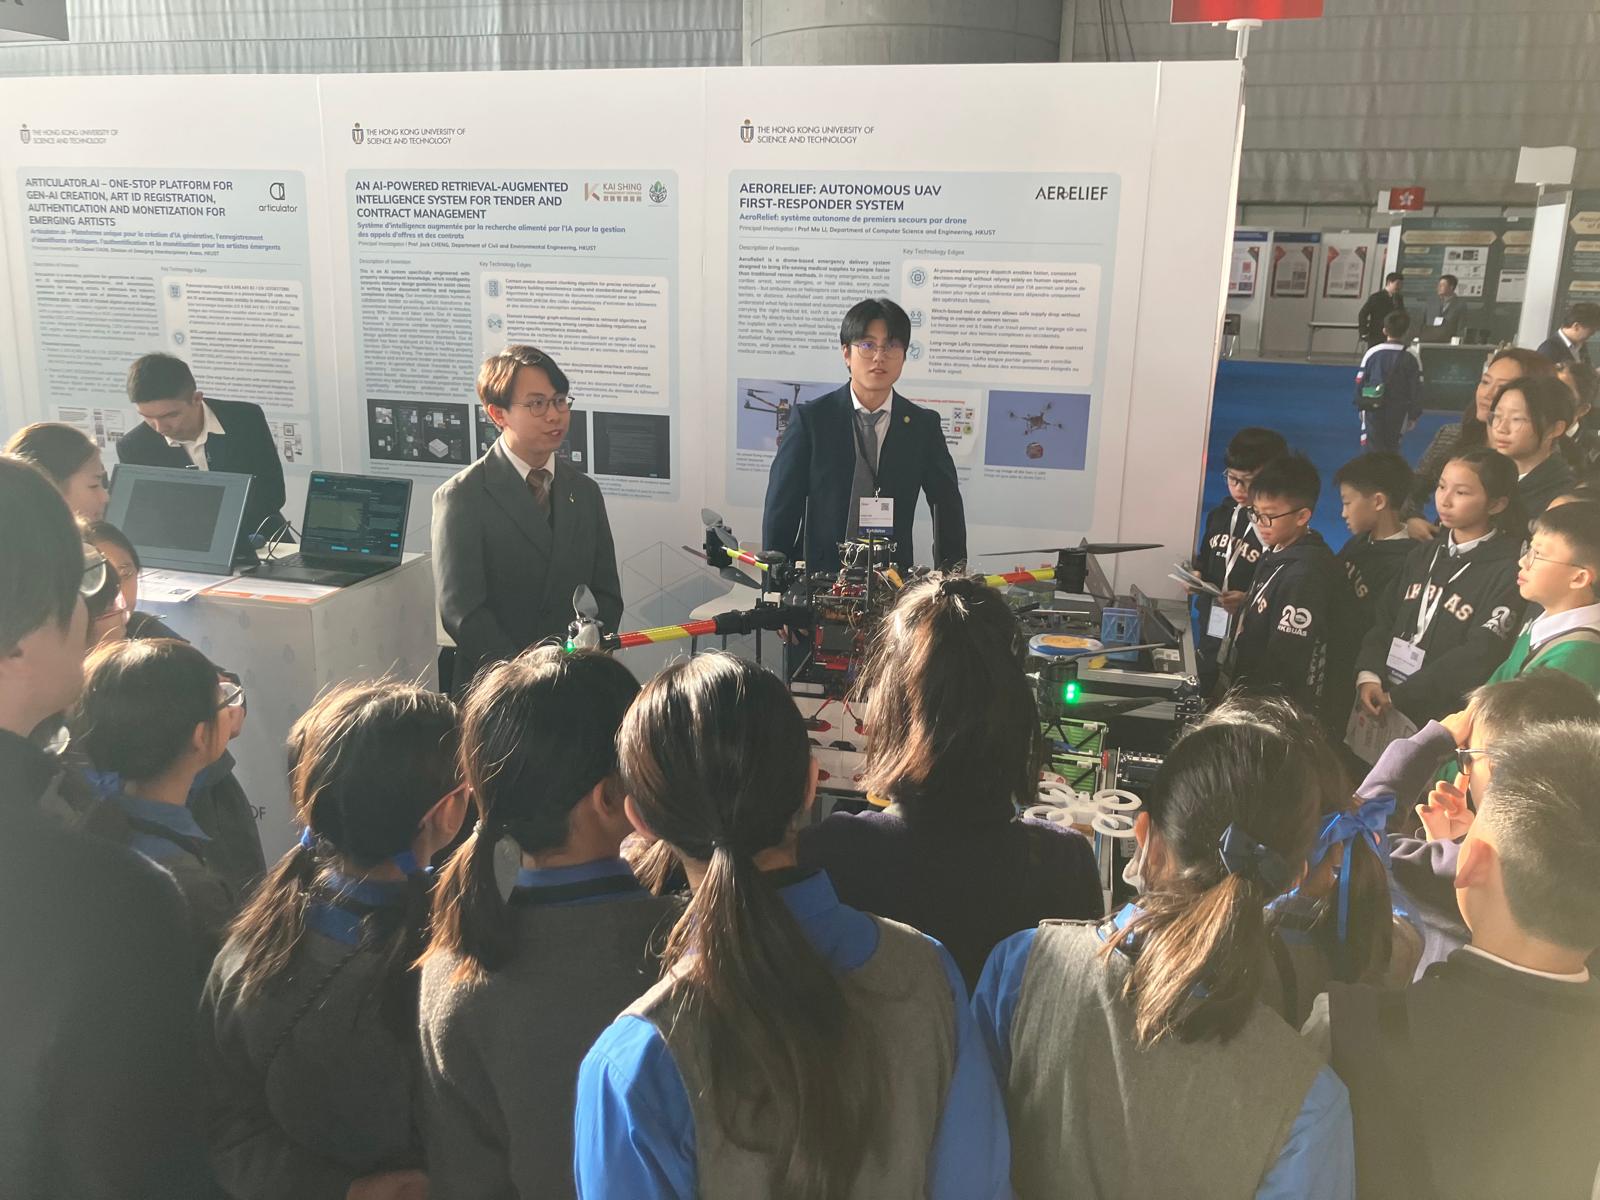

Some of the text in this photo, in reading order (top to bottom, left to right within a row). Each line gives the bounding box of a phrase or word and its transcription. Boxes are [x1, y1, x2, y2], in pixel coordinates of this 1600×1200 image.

[758, 126, 875, 134] THE HONG KONG UNIVERSITY OF
[367, 137, 452, 145] SCIENCE AND TECHNOLOGY
[757, 136, 857, 144] SCIENCE AND TECHNOLOGY
[25, 178, 100, 188] ARTICULATOR.AI
[109, 179, 156, 189] ONE-STOP
[159, 180, 210, 190] PLATFORM
[213, 181, 233, 191] FOR
[355, 181, 569, 192] AN AI-POWERED RETRIEVAL-AUGMENTED
[602, 183, 642, 191] KAI SHING
[739, 183, 942, 196] AERORELIEF: AUTONOMOUS UAV
[26, 190, 216, 204] GEN-AI CREATION, ART ID REGISTRATION,
[356, 195, 562, 206] INTELLIGENCE SYSTEM FOR TENDER AND
[258, 204, 298, 213] articulator
[740, 198, 904, 211] FIRST-RESPONDER SYSTEM
[28, 204, 226, 216] AUTHENTICATION AND MONETIZATION FOR
[357, 208, 487, 219] CONTRACT MANAGEMENT
[29, 216, 116, 226] EMERGING ARTISTS
[780, 214, 810, 223] système
[812, 214, 850, 222] autonome
[863, 215, 896, 224] premiers
[384, 223, 425, 231] d'intelligence
[427, 224, 463, 232] augmentée
[600, 226, 626, 234] gestion
[370, 232, 391, 240] appels
[947, 249, 965, 257] Edges
[490, 261, 515, 269] Technology
[1280, 604, 1312, 629] 20
